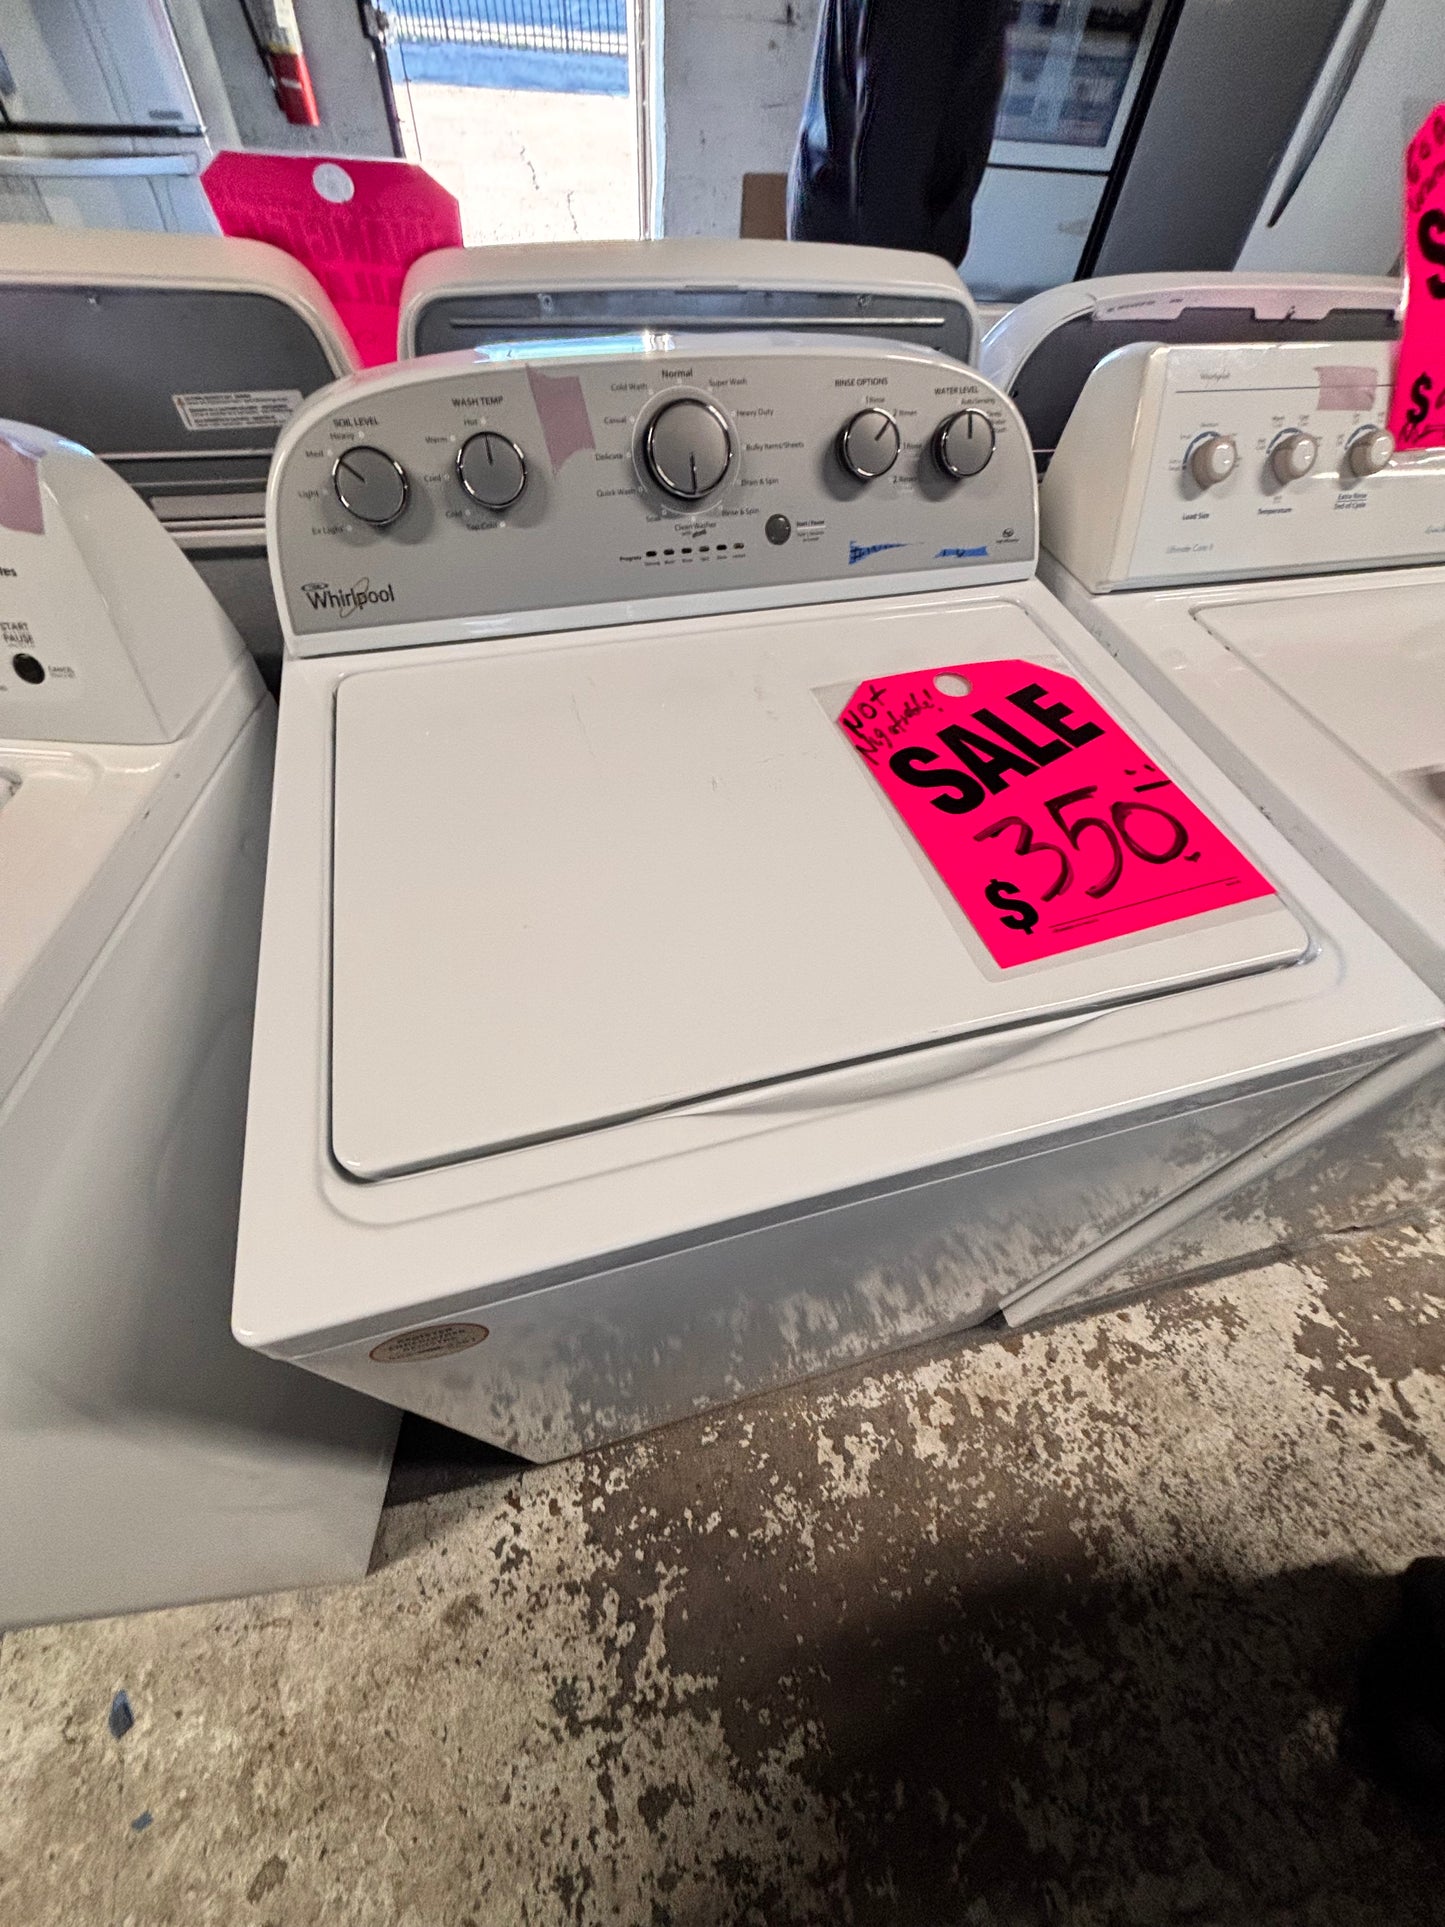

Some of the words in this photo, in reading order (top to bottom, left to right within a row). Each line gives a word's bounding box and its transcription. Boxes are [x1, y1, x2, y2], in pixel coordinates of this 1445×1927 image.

[661, 368, 693, 379] Normal
[611, 384, 627, 392] Cold
[628, 382, 648, 391] Wash
[709, 379, 728, 388] Super
[729, 378, 747, 386] Wash
[834, 379, 855, 388] RINSE
[856, 377, 888, 387] OPTIONS
[935, 386, 959, 396] WATER
[959, 385, 979, 394] LEVEL
[452, 397, 479, 408] WASH
[480, 395, 504, 405] TEMP
[758, 408, 774, 416] Duty
[333, 418, 352, 428] SOIL
[353, 416, 378, 427] LEVEL
[330, 431, 355, 441] Heavy
[597, 489, 616, 497] Quick
[306, 583, 395, 611] Whirlpool
[889, 683, 1105, 815] SALE
[984, 879, 1039, 935] $
